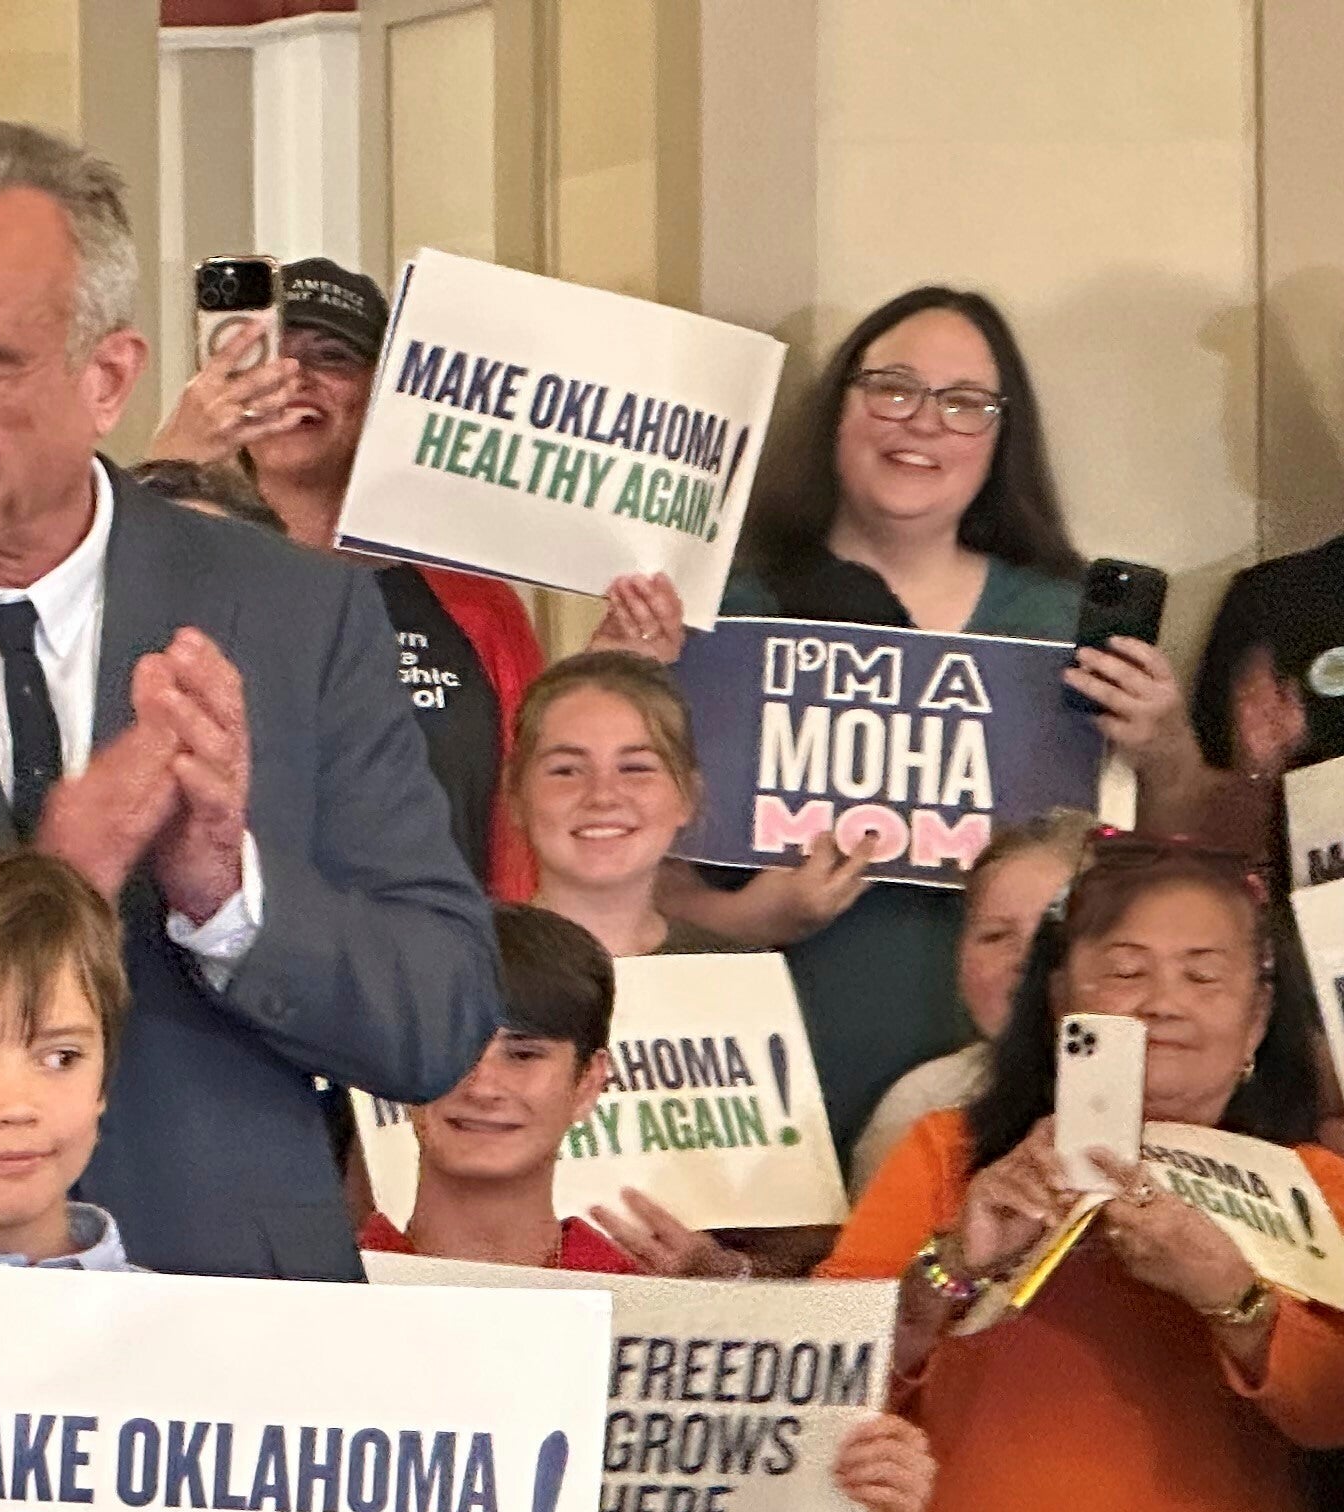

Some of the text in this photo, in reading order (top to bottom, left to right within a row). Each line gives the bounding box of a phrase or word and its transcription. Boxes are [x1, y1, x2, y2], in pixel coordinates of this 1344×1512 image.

[396, 340, 730, 474] MAKE OKLAHOMA
[414, 412, 616, 508] HEALTHY
[763, 636, 992, 715] I'M A
[757, 701, 993, 810] MOHA
[753, 795, 992, 872] MOM
[603, 1036, 755, 1093] AHOMA
[609, 1335, 873, 1406] FREEDOM
[603, 1409, 802, 1475] GROWS
